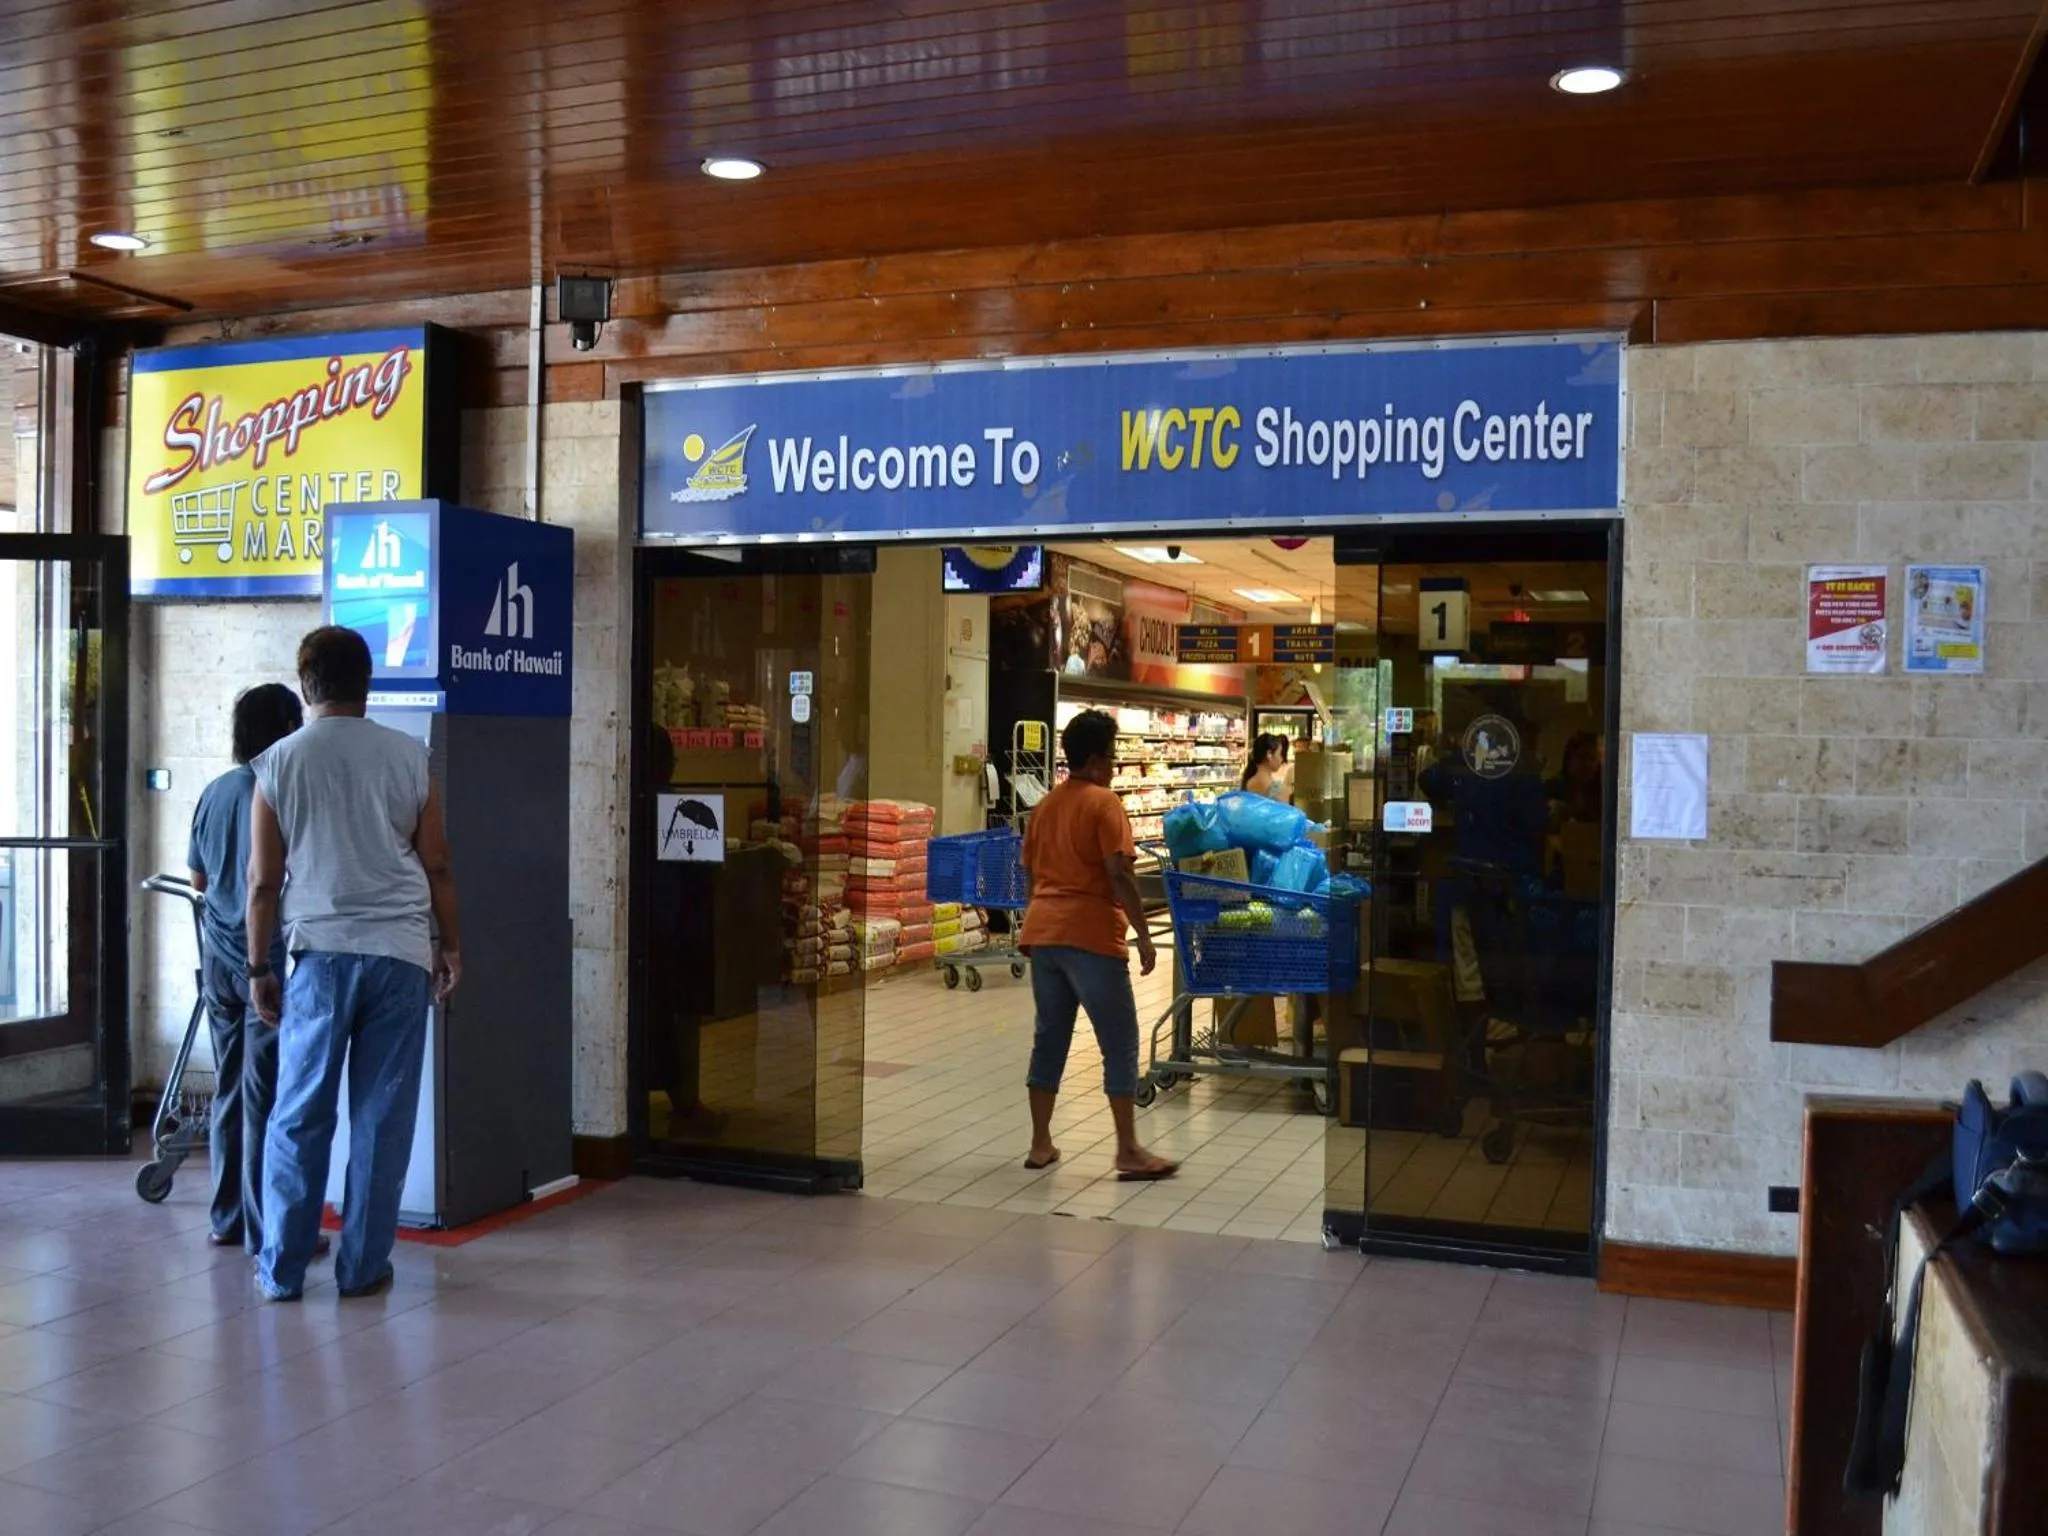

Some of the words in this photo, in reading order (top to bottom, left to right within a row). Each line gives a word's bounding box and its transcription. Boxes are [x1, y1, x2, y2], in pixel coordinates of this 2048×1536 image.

[144, 346, 412, 494] Shopping
[1121, 404, 1241, 471] WCTC
[1255, 402, 1446, 480] Shopping
[1453, 398, 1594, 462] Center
[767, 435, 976, 494] Welcome
[983, 427, 1040, 486] To
[252, 470, 401, 515] CENTER
[243, 518, 324, 562] MAR
[1430, 601, 1447, 641] 1
[451, 645, 492, 671] Bank
[494, 649, 513, 672] of
[513, 650, 563, 675] Hawaii
[1196, 640, 1219, 648] PIZZA
[1248, 632, 1260, 656] 1
[662, 828, 719, 840] UMBRELLA
